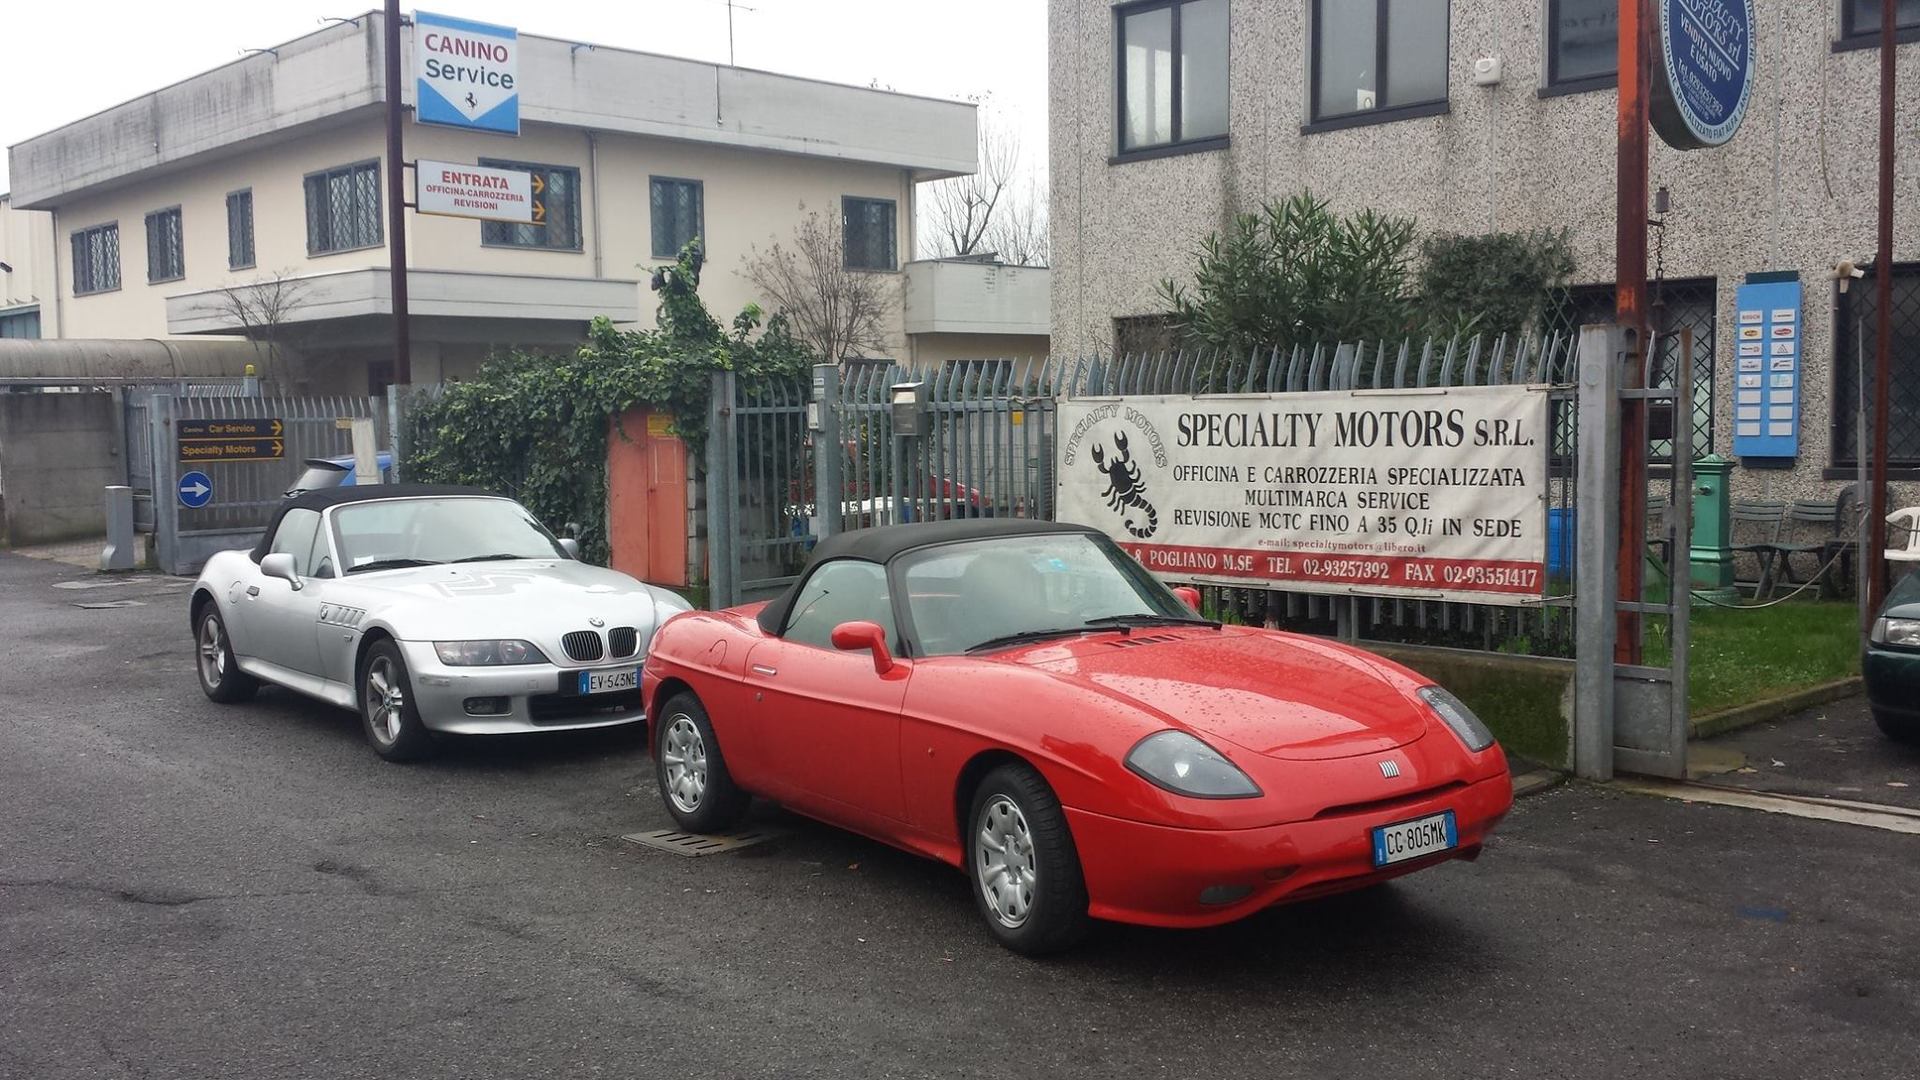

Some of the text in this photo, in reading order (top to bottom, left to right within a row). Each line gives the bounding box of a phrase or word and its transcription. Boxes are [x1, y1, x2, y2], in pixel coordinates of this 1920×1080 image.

[424, 33, 508, 63] CANINO
[1681, 13, 1708, 56] VENDITA
[1708, 47, 1732, 81] NUOVO
[426, 58, 514, 89] Service
[1690, 44, 1695, 58] E
[1696, 50, 1717, 82] USATO
[426, 184, 524, 203] OFFICINA-CARROZZERIA
[441, 170, 509, 190] ENTRATA
[454, 198, 498, 210] REVISIONI
[208, 424, 224, 433] Car
[225, 424, 256, 433] Service
[1064, 404, 1168, 468] SPECIALTY MOTORS
[1177, 409, 1535, 448] SPECIALTY MOTORS S.R.L.
[182, 444, 256, 456] Specialty Motors
[1173, 464, 1526, 487] OFFICINA E CARROZZERIA SPECIALIZZATA
[1244, 489, 1430, 510] MULTIMARCA SERVICE
[1174, 509, 1251, 528] REVISIONE
[1259, 512, 1302, 530] MCTC
[1310, 514, 1349, 532] FINO
[1357, 516, 1368, 533] A
[1378, 516, 1397, 534] 35
[1442, 518, 1462, 536] IN
[1472, 518, 1523, 538] SEDE
[1150, 549, 1216, 569] POGLIANO
[1223, 554, 1253, 572] M.SE
[1267, 556, 1296, 574] TEL.
[1302, 558, 1390, 579] 02-93257392
[1405, 563, 1435, 582] FAX
[1443, 564, 1538, 587] 02-93551417
[1386, 831, 1403, 855] CG
[1407, 820, 1446, 849] 805MK
